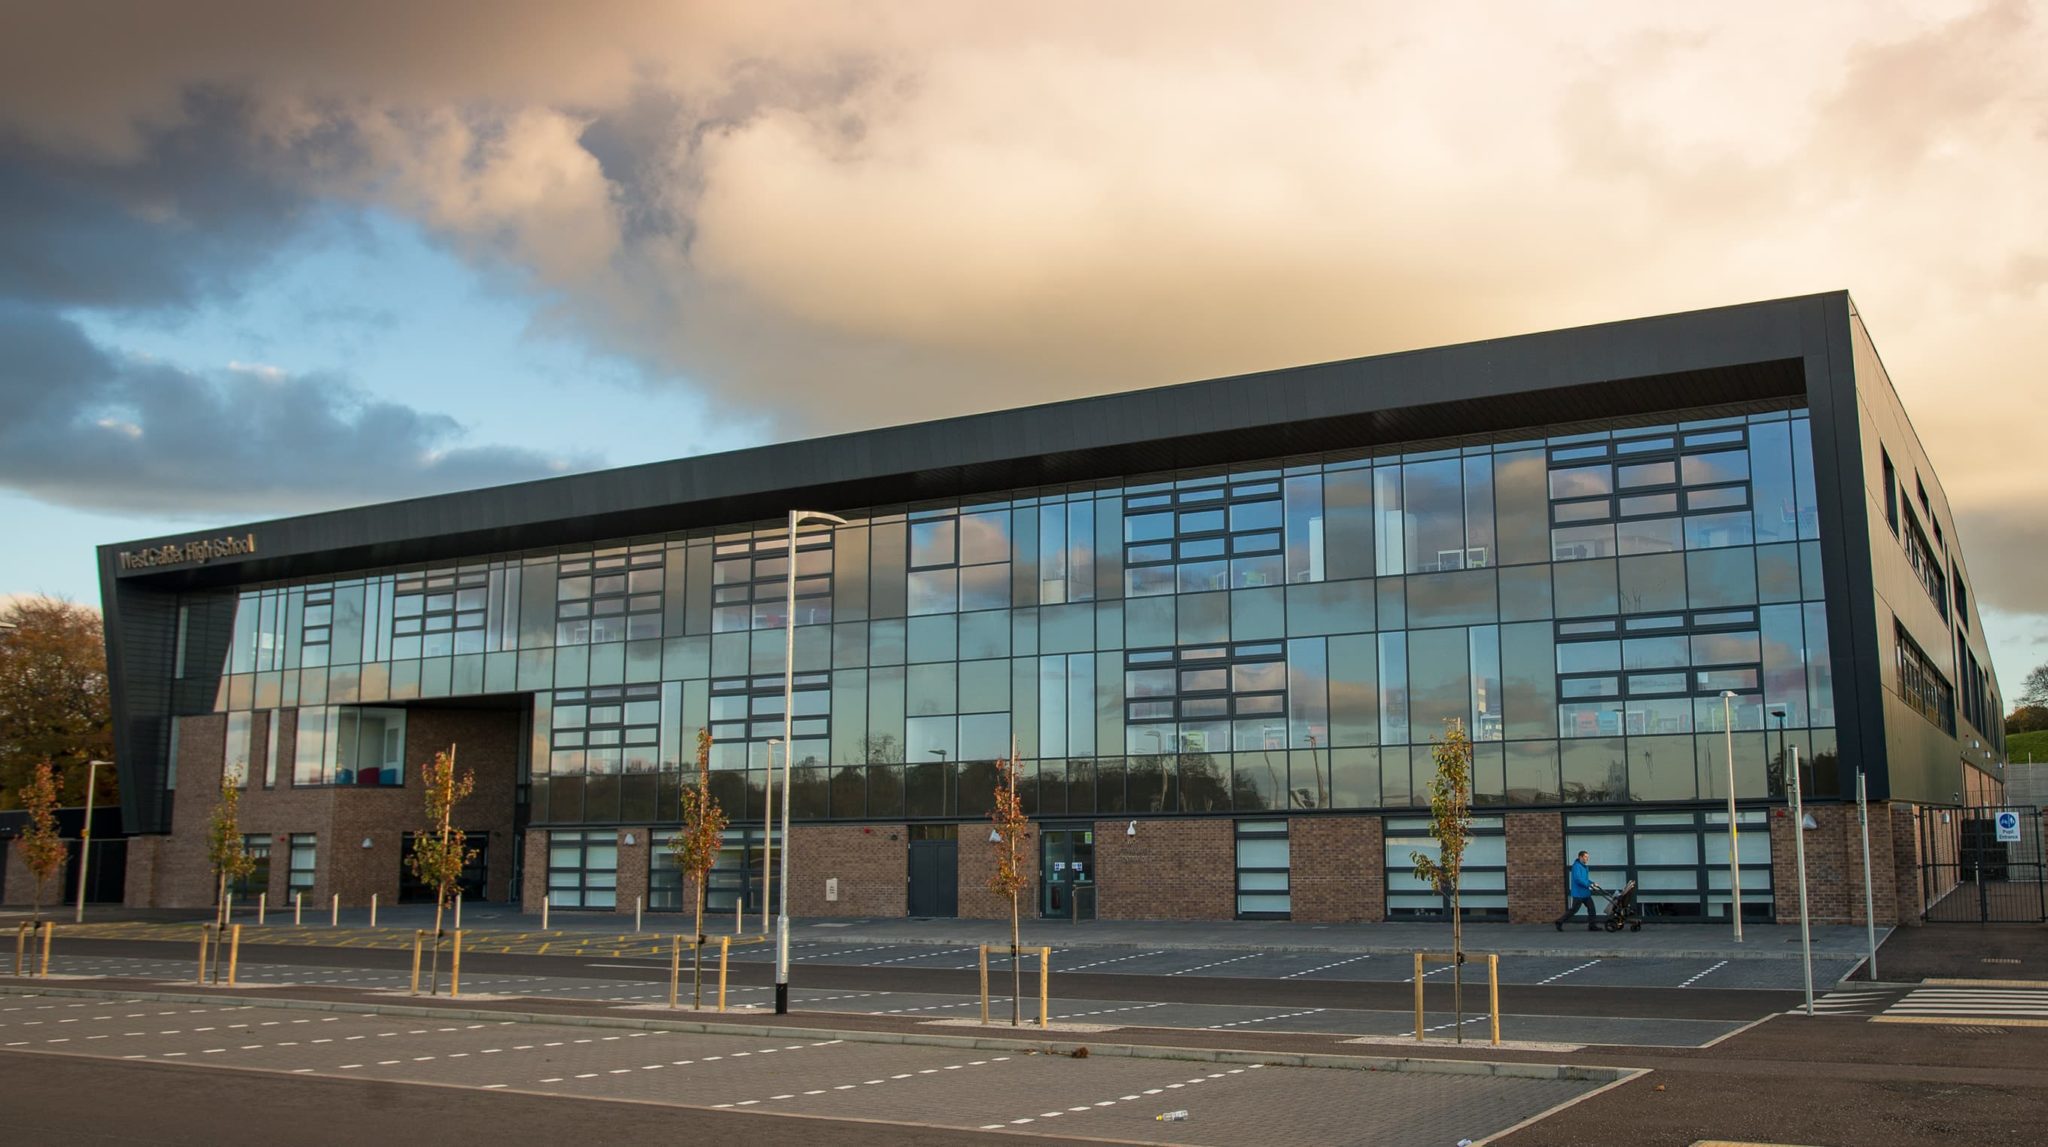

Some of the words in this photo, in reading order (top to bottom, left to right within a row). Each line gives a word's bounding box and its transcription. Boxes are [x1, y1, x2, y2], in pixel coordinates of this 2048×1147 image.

[120, 549, 149, 568] West
[148, 545, 184, 566] Calder
[185, 540, 212, 564] High
[213, 533, 255, 558] School
